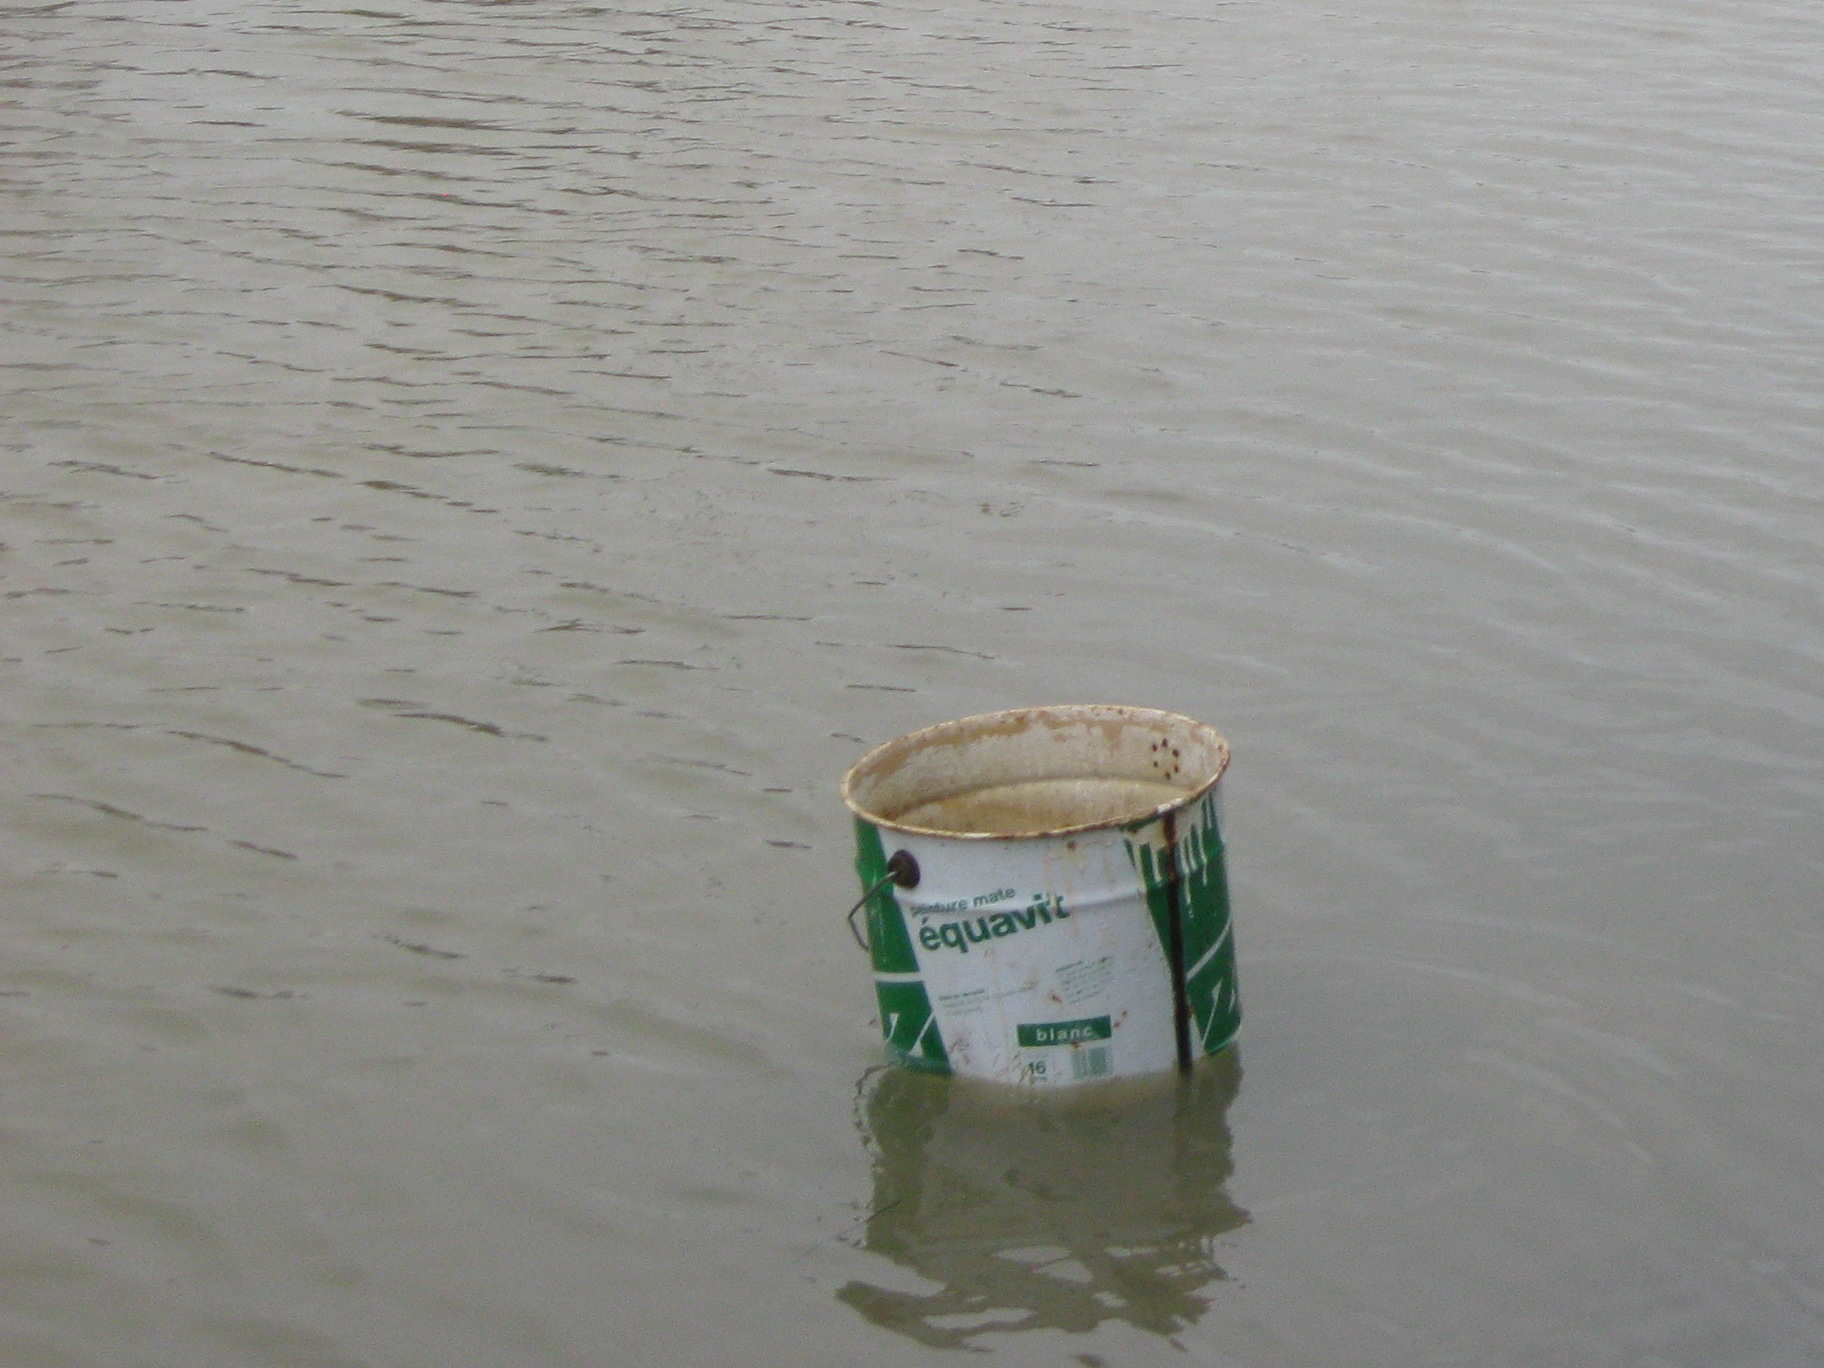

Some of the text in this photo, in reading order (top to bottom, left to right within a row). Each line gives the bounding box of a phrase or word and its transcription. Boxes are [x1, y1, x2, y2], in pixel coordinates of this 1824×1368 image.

[972, 888, 1016, 907] mate
[918, 892, 1071, 953] équavit
[1035, 1026, 1092, 1042] blanc
[1027, 1060, 1046, 1074] 16
